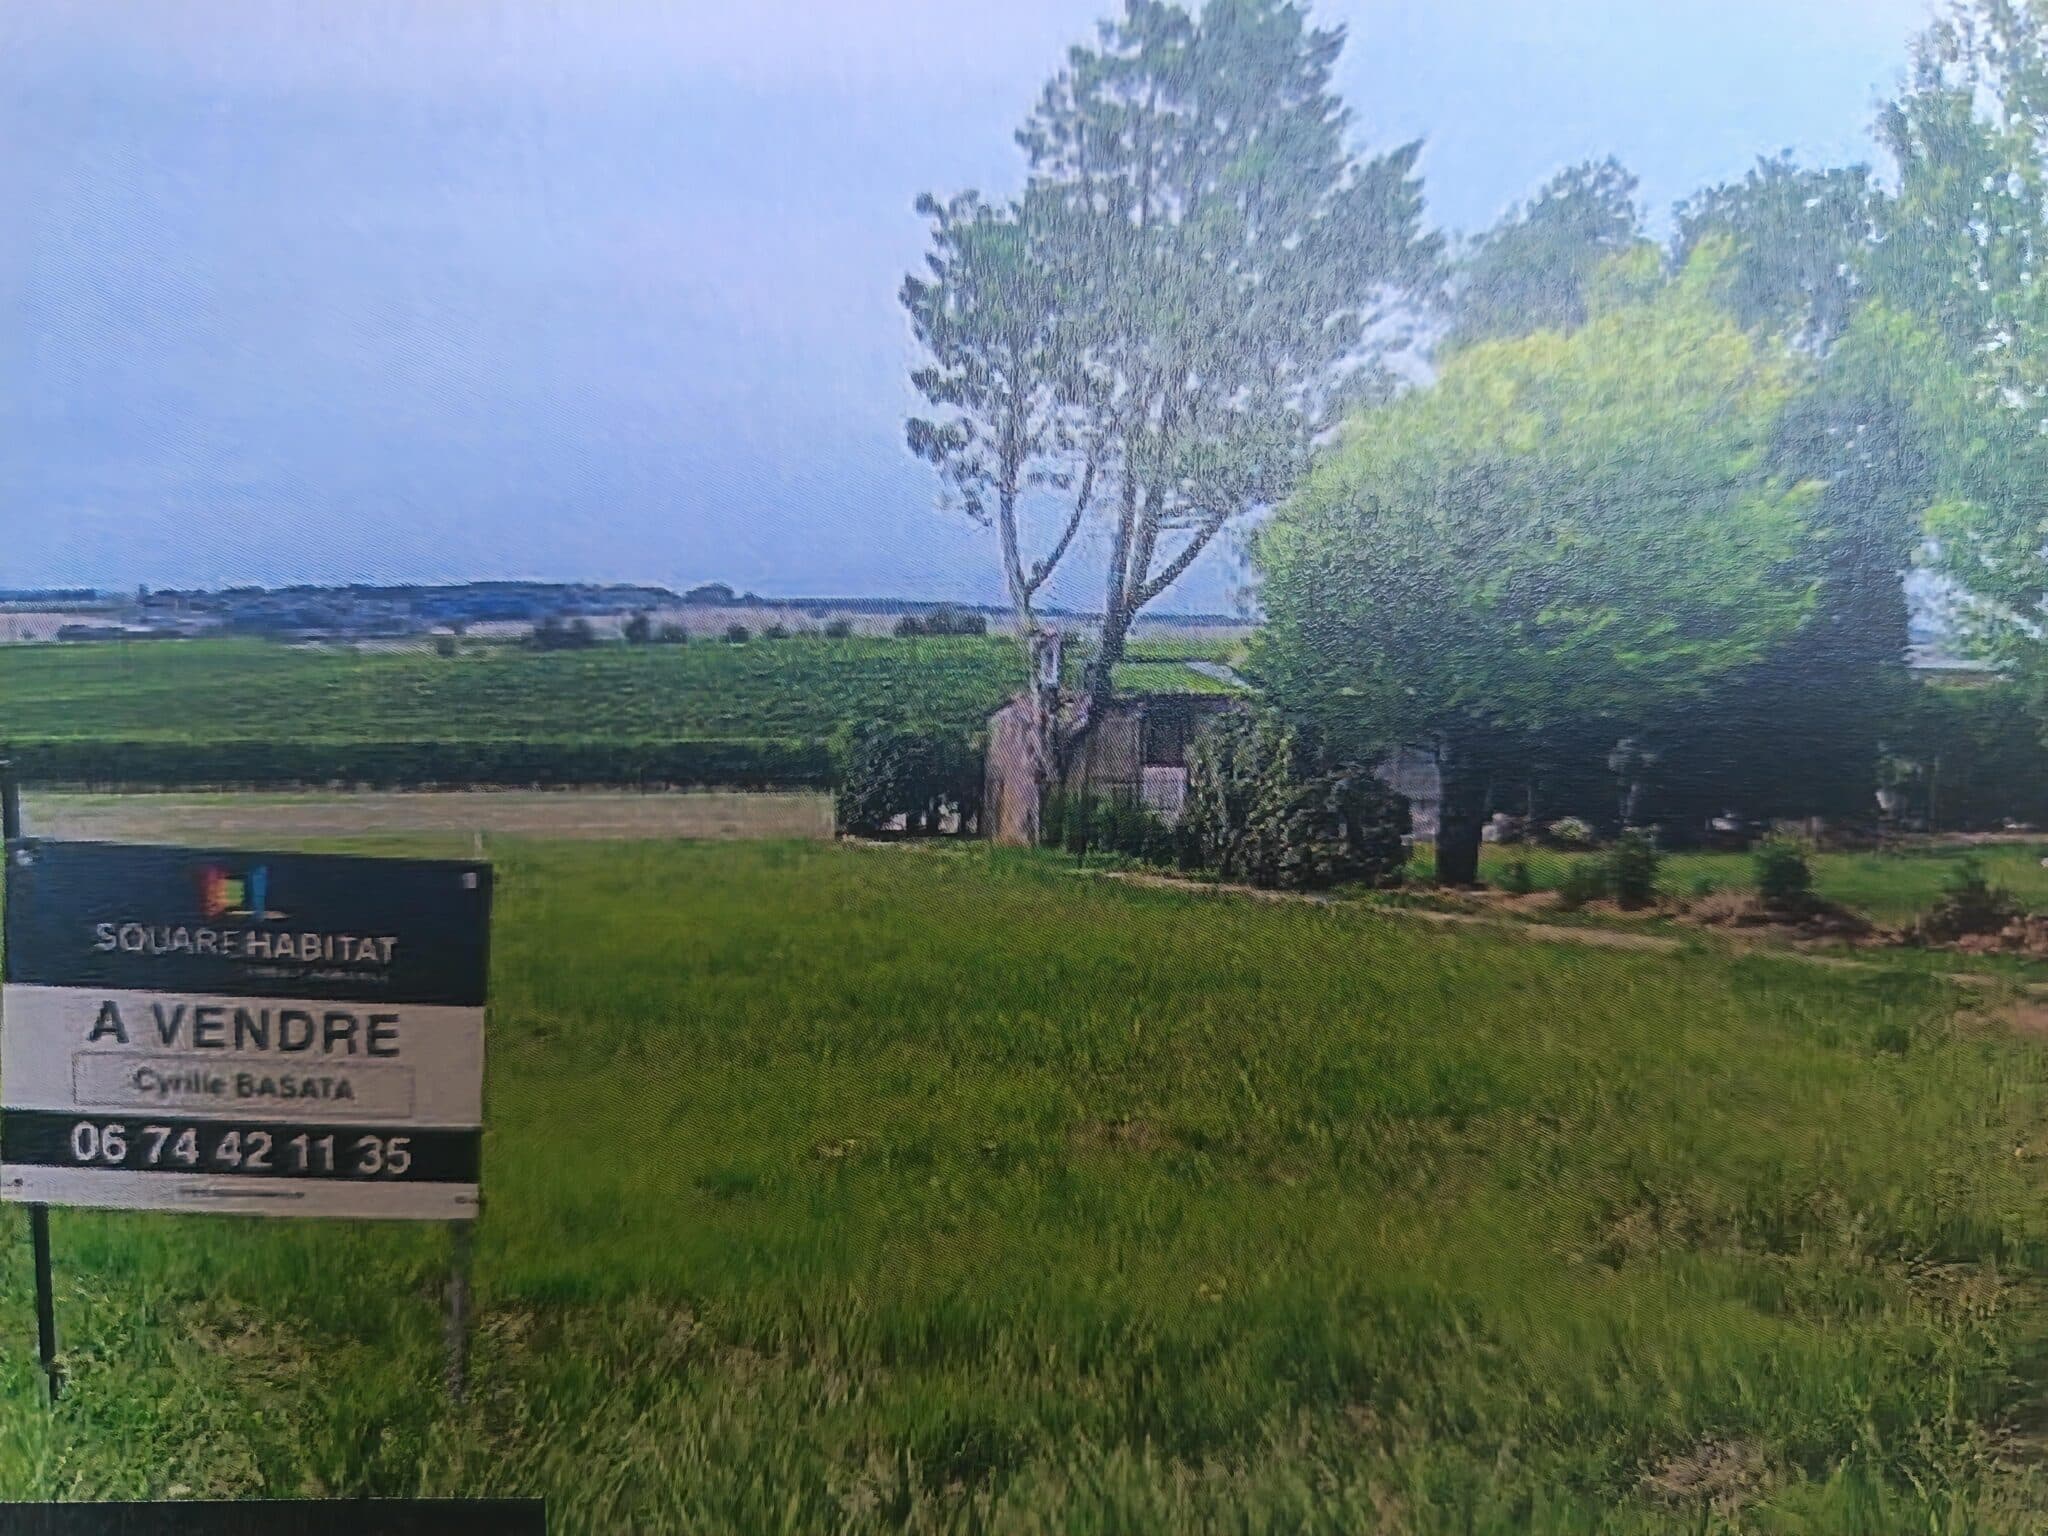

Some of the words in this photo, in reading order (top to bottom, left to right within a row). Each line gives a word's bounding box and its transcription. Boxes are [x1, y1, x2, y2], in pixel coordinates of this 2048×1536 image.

[246, 929, 398, 962] HABITAT
[89, 1000, 130, 1044] A
[153, 1003, 400, 1057] VENDRE
[133, 1066, 225, 1096] Cyrille
[236, 1073, 355, 1100] BASATA
[71, 1121, 127, 1162] 06
[143, 1127, 199, 1165] 74
[216, 1131, 273, 1168] 42
[290, 1134, 336, 1171] 11
[358, 1136, 412, 1175] 35
